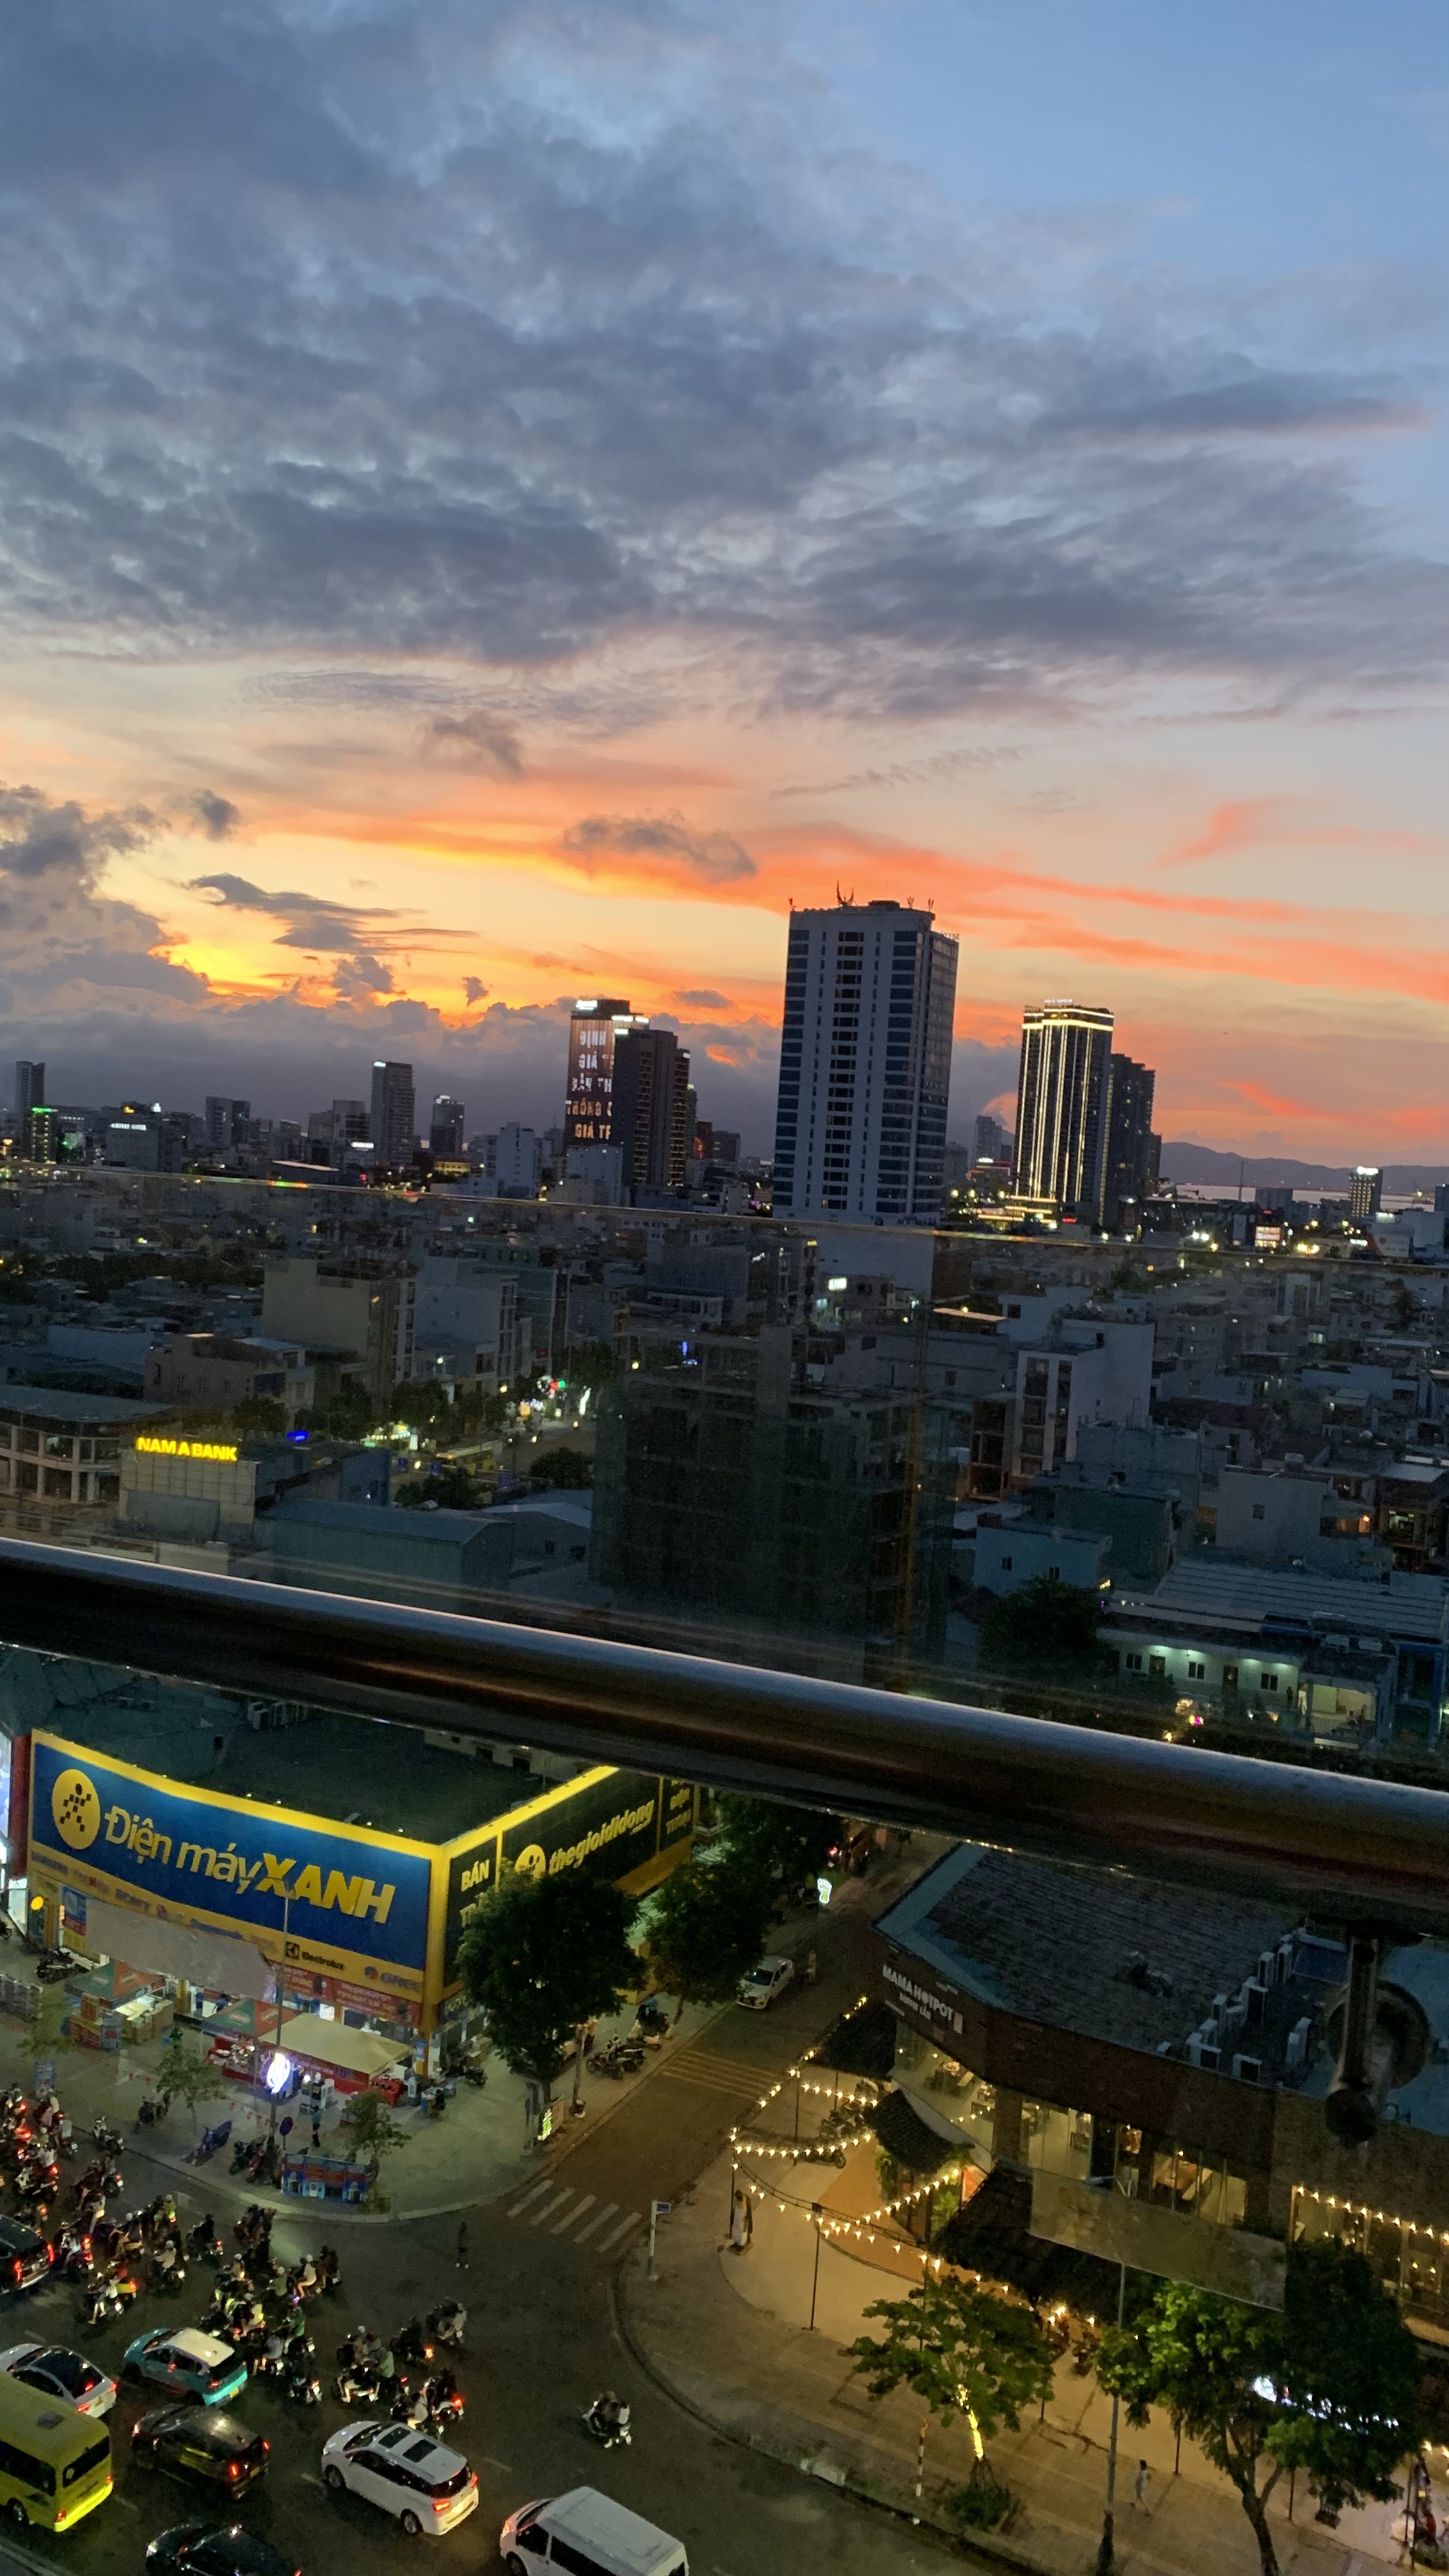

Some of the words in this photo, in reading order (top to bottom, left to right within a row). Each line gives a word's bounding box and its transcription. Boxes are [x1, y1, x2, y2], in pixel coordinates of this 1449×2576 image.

[137, 1437, 177, 1454] NAM
[178, 1441, 190, 1456] A
[192, 1443, 237, 1462] BANK
[105, 1805, 172, 1864] Điện
[461, 1859, 490, 1892] BÁN
